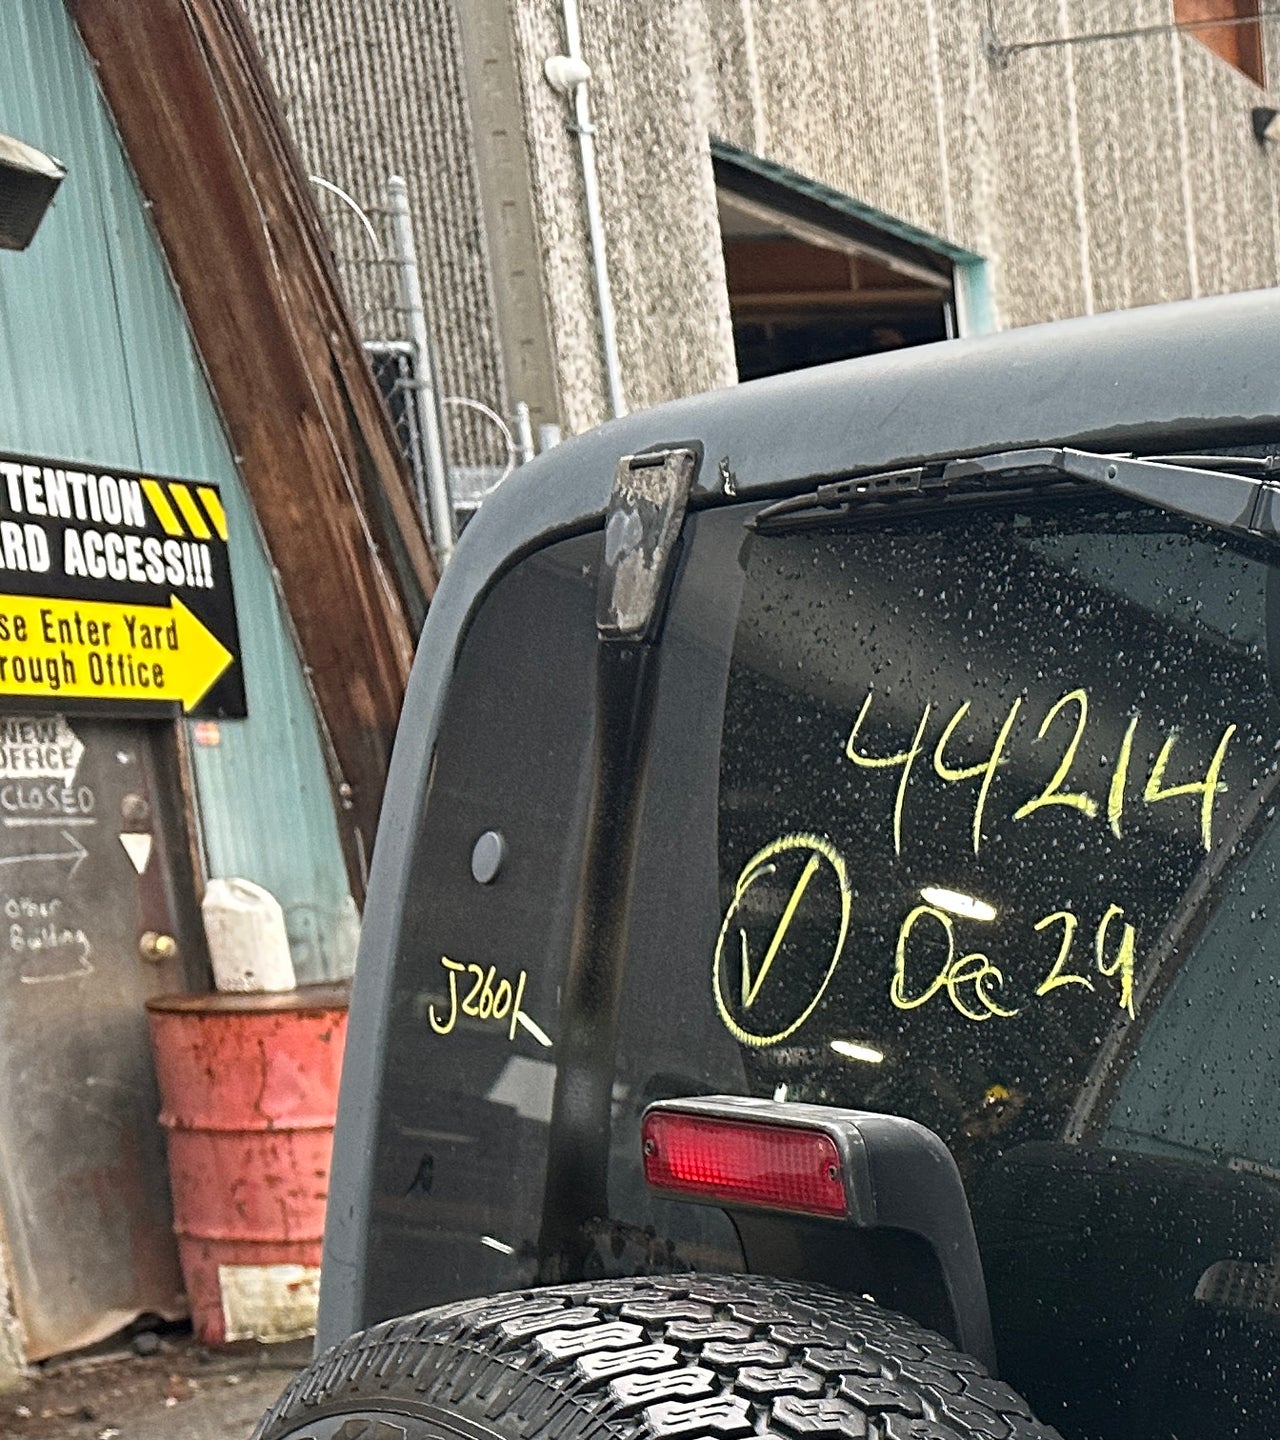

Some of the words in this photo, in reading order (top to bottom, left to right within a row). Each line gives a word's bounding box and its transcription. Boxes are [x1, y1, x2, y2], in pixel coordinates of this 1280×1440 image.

[64, 527, 214, 589] ACCESS!!!
[40, 608, 112, 647] Enter
[123, 613, 180, 651] Yard
[88, 650, 165, 689] Office
[1, 784, 95, 814] CLOSED
[846, 688, 1238, 856] 44214
[891, 904, 1019, 1022] Dec
[1033, 904, 1137, 1021] 29
[429, 955, 528, 1042] J2601
